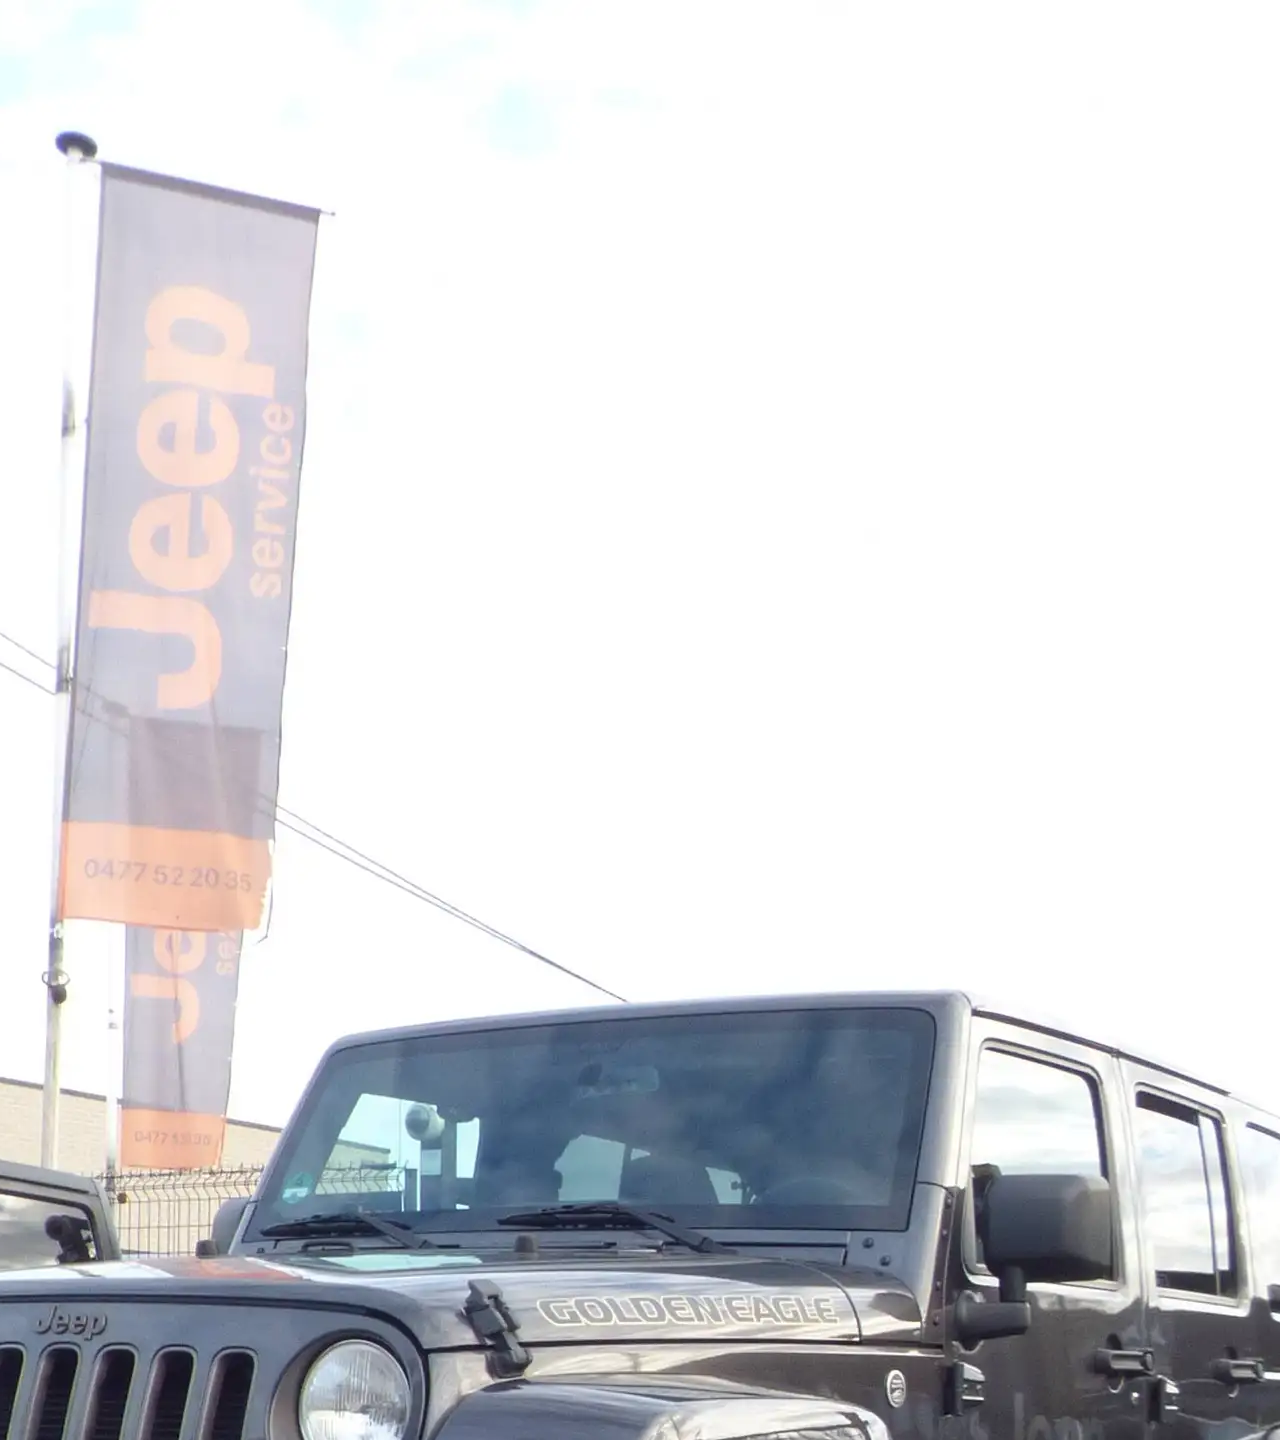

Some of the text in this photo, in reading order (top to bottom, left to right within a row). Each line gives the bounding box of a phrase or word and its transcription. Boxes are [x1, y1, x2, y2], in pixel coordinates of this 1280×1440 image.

[88, 284, 276, 710] Jeep
[249, 402, 295, 599] service
[84, 859, 252, 893] 0477 52 20 35
[129, 928, 208, 1046] Je
[36, 1304, 108, 1341] Jeep
